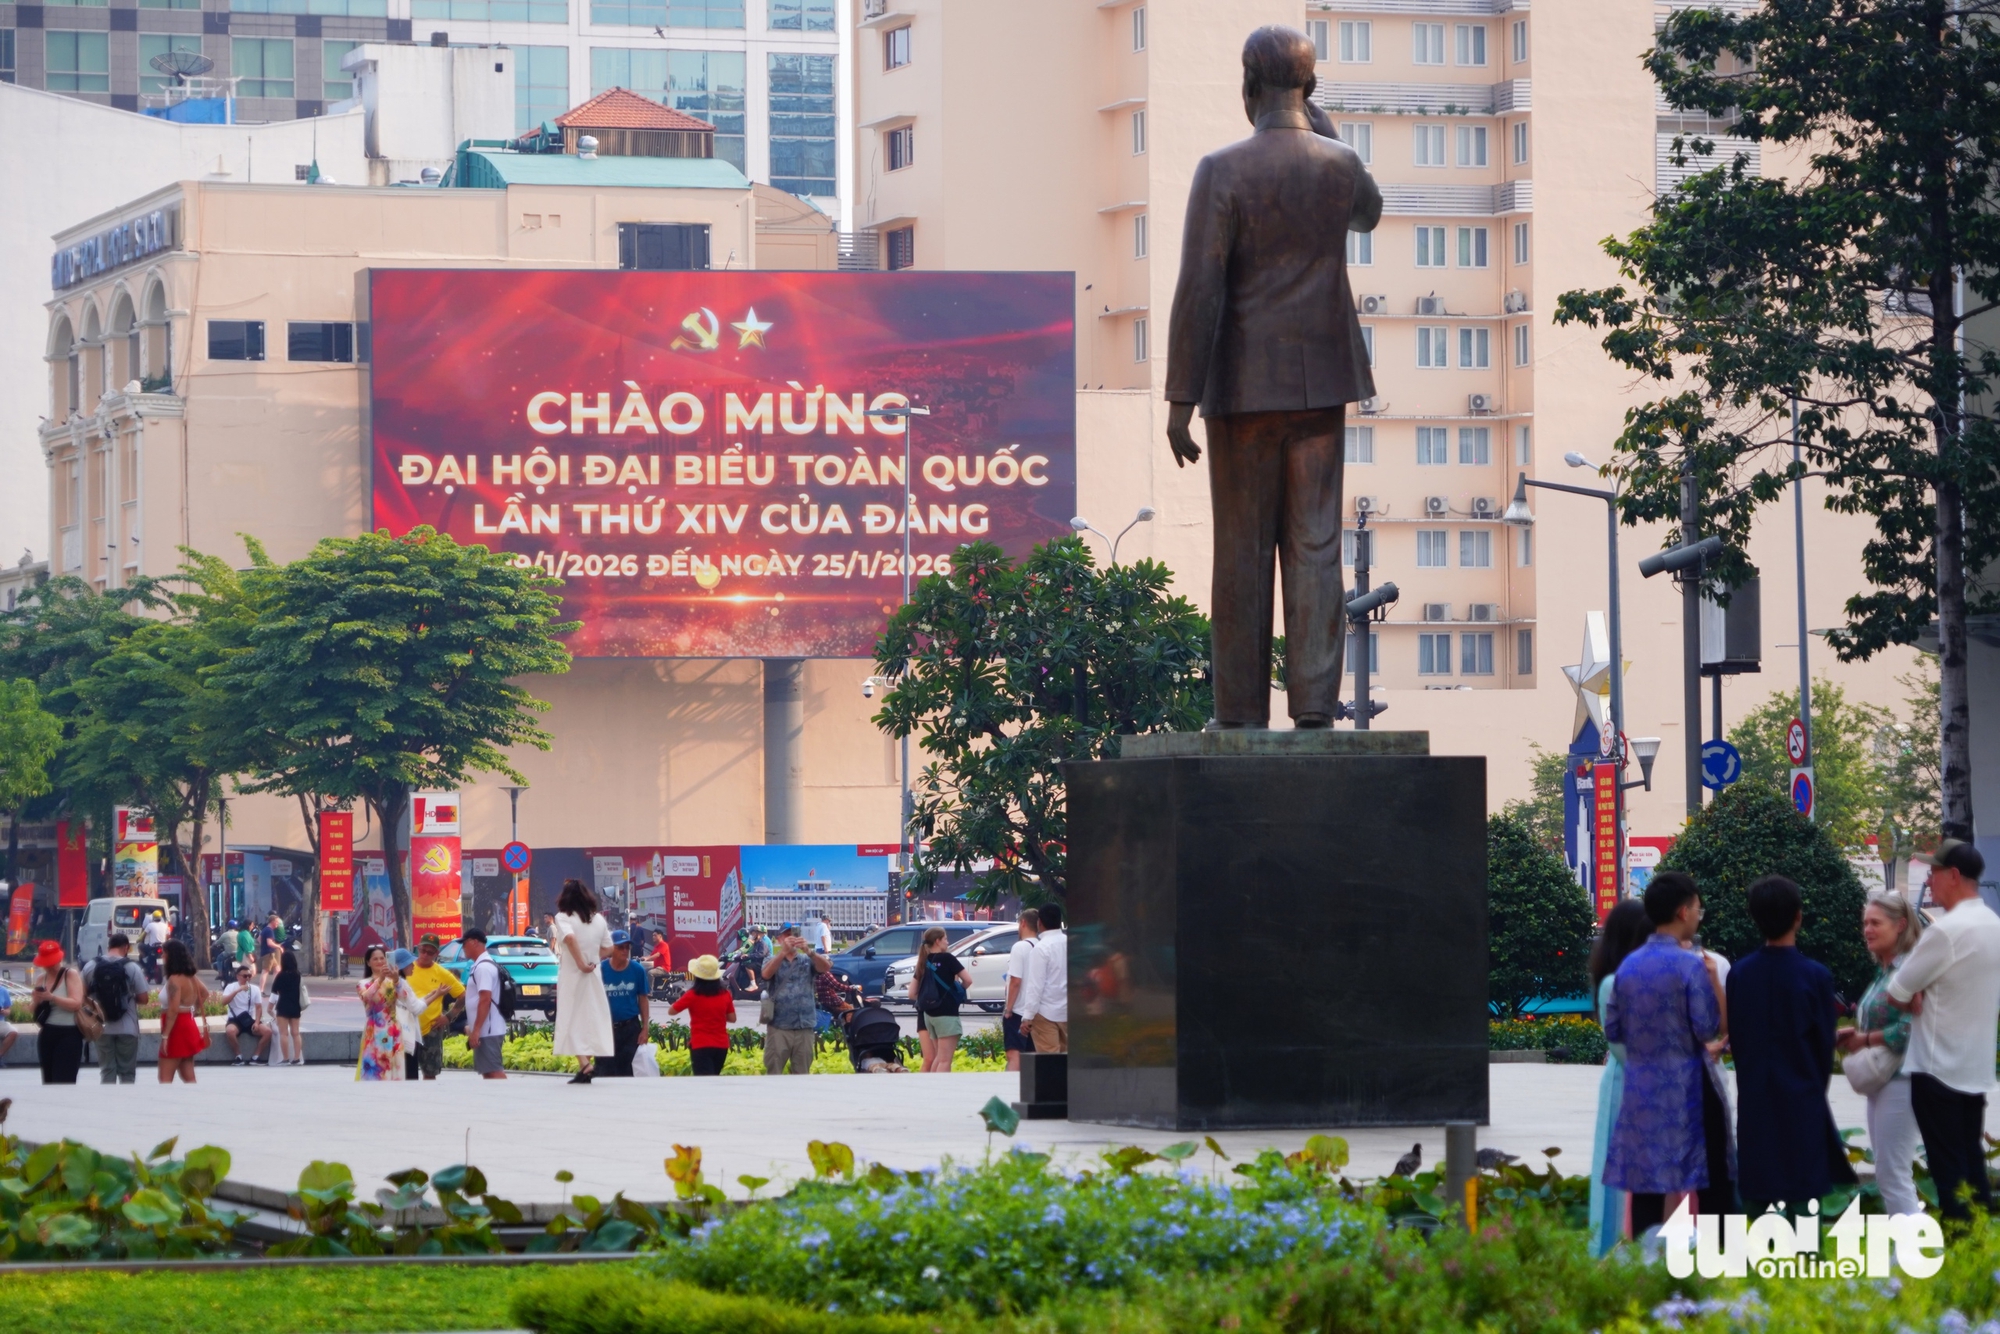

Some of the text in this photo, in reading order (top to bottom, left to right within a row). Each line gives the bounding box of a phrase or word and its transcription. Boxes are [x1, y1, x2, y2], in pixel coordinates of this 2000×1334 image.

[527, 380, 909, 436] CHÀO MỪNG
[398, 443, 1049, 495] ĐẠI HỘI ĐẠI BIỂU TOÀN QUỐC
[474, 490, 989, 535] LẦN THỨ XIV CỦA ĐẢNG
[505, 546, 952, 579] 9/1/2026 ĐẾN NGÀY 25/1/2026
[1576, 777, 1594, 789] Bank
[425, 810, 455, 818] HDBank
